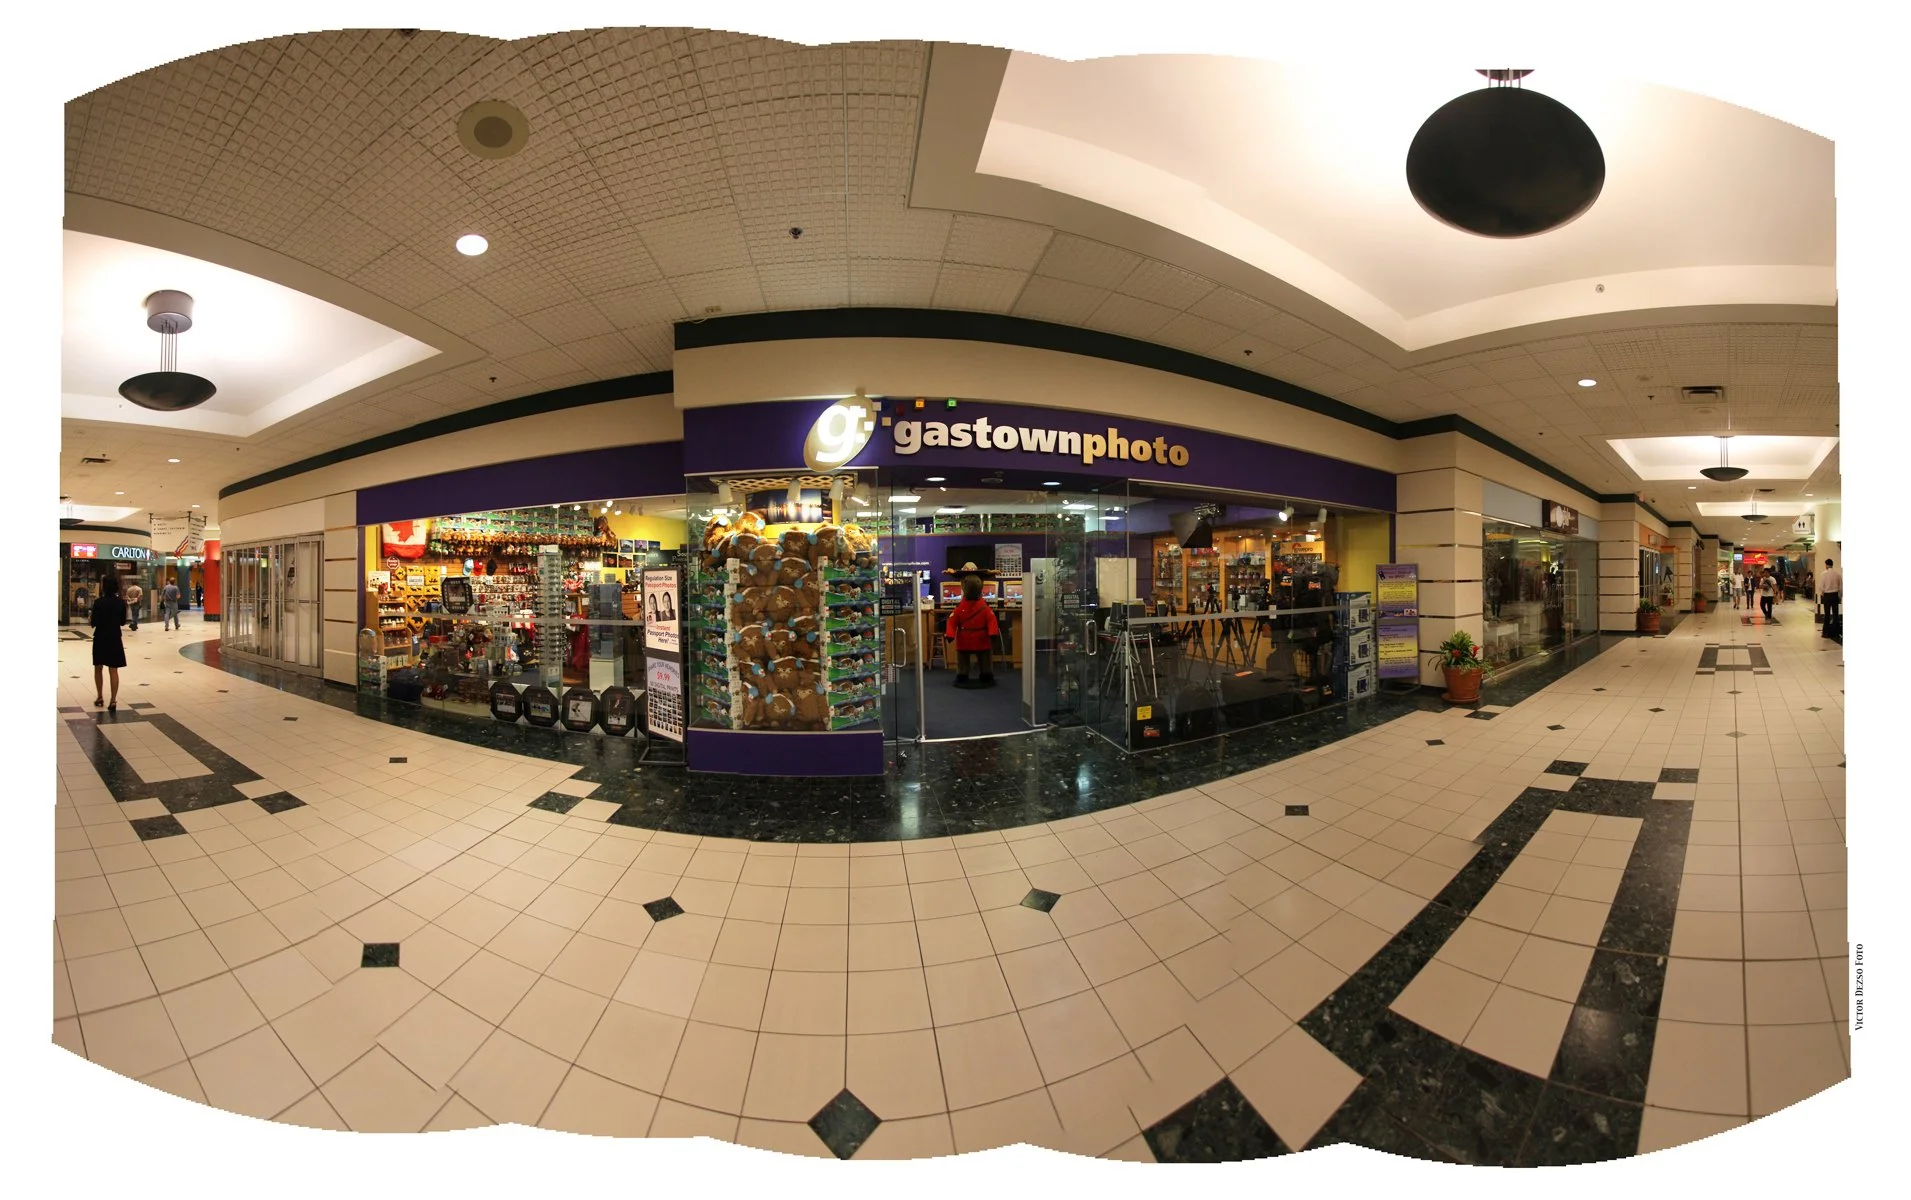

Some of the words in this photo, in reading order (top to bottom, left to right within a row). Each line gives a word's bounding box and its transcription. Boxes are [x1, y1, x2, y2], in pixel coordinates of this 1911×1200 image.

[893, 416, 1190, 467] gastownphoto
[111, 546, 146, 559] CARLTON
[646, 629, 665, 638] Passport
